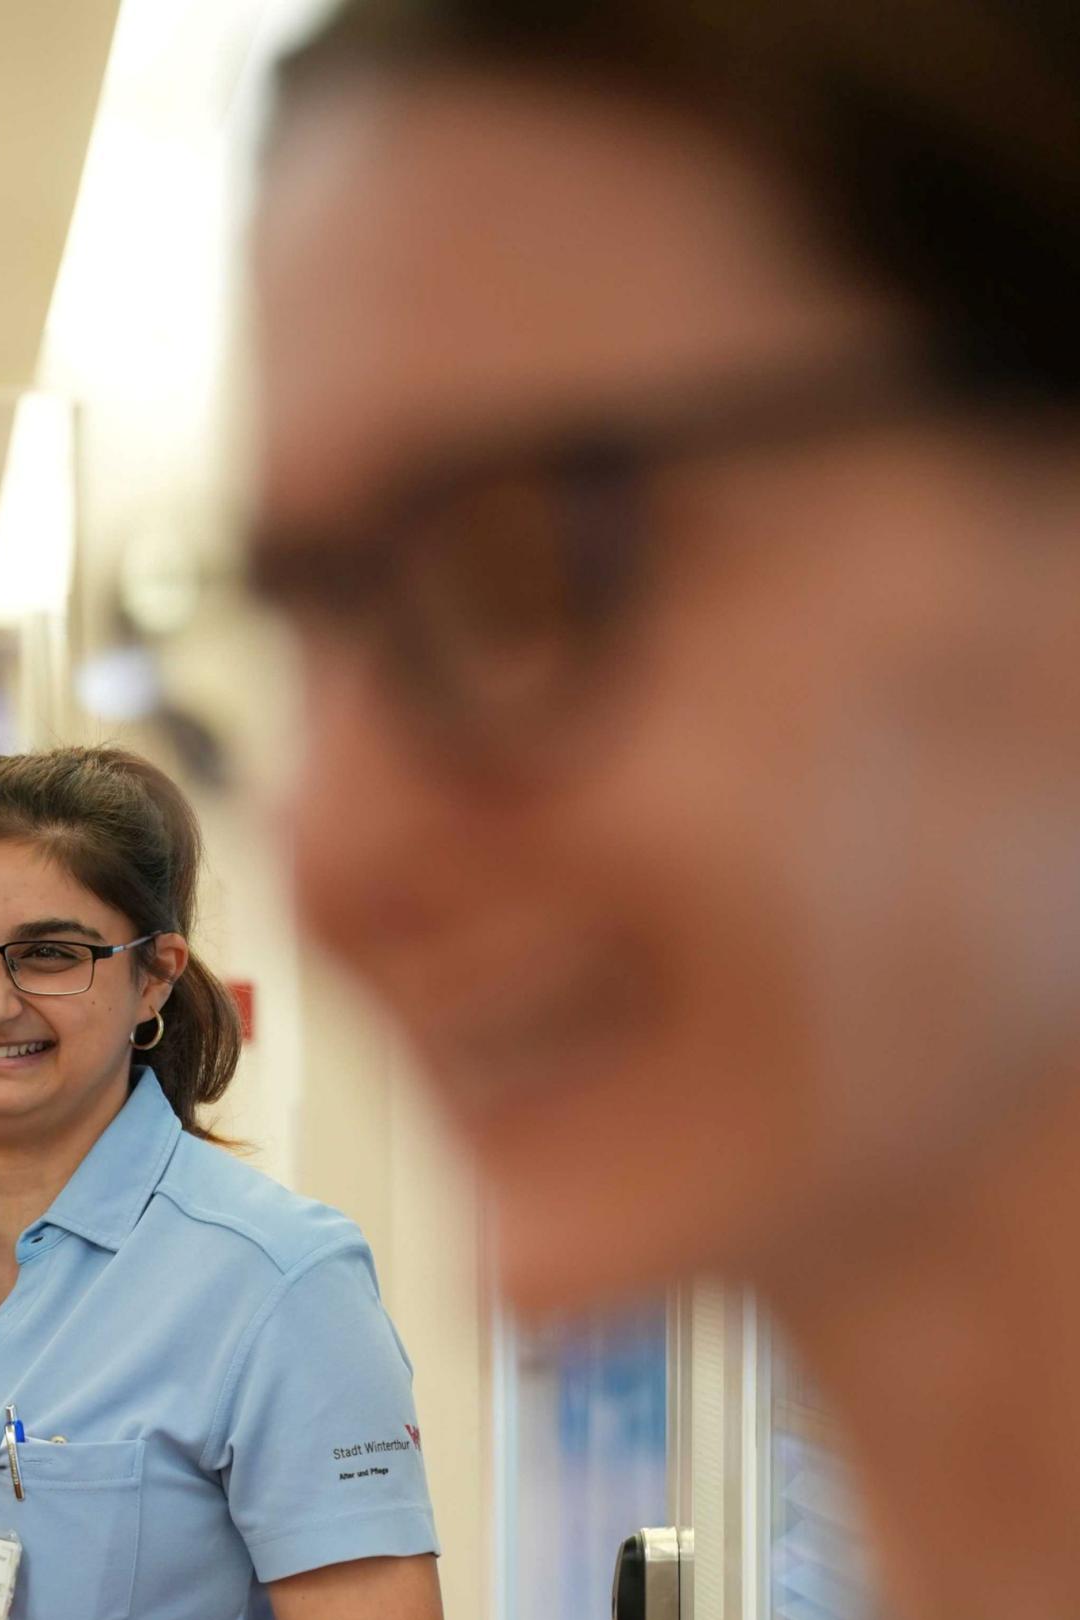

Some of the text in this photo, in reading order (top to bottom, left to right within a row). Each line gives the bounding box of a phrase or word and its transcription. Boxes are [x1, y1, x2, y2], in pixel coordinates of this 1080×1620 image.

[333, 1440, 409, 1460] Stadt Winterthur
[357, 1469, 369, 1477] und
